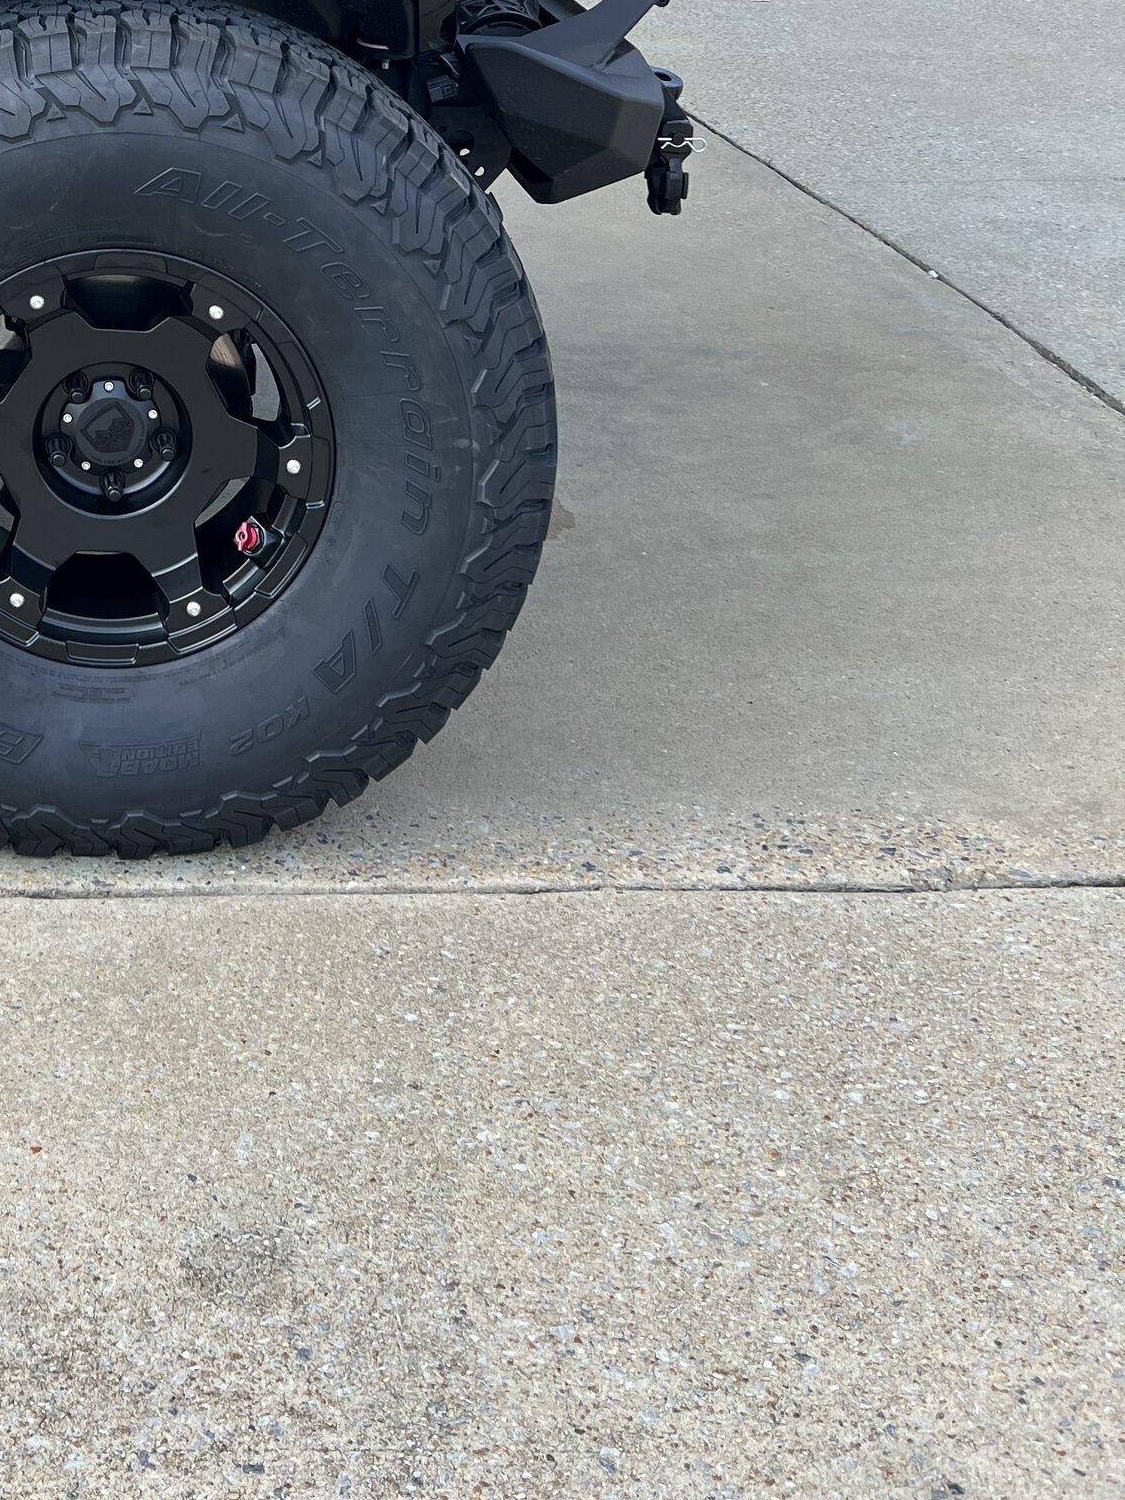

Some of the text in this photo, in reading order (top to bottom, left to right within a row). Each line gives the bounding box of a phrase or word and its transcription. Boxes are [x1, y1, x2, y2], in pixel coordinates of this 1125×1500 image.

[133, 167, 441, 536] All-Terrain
[310, 563, 420, 694] T/A
[227, 696, 311, 757] KO2
